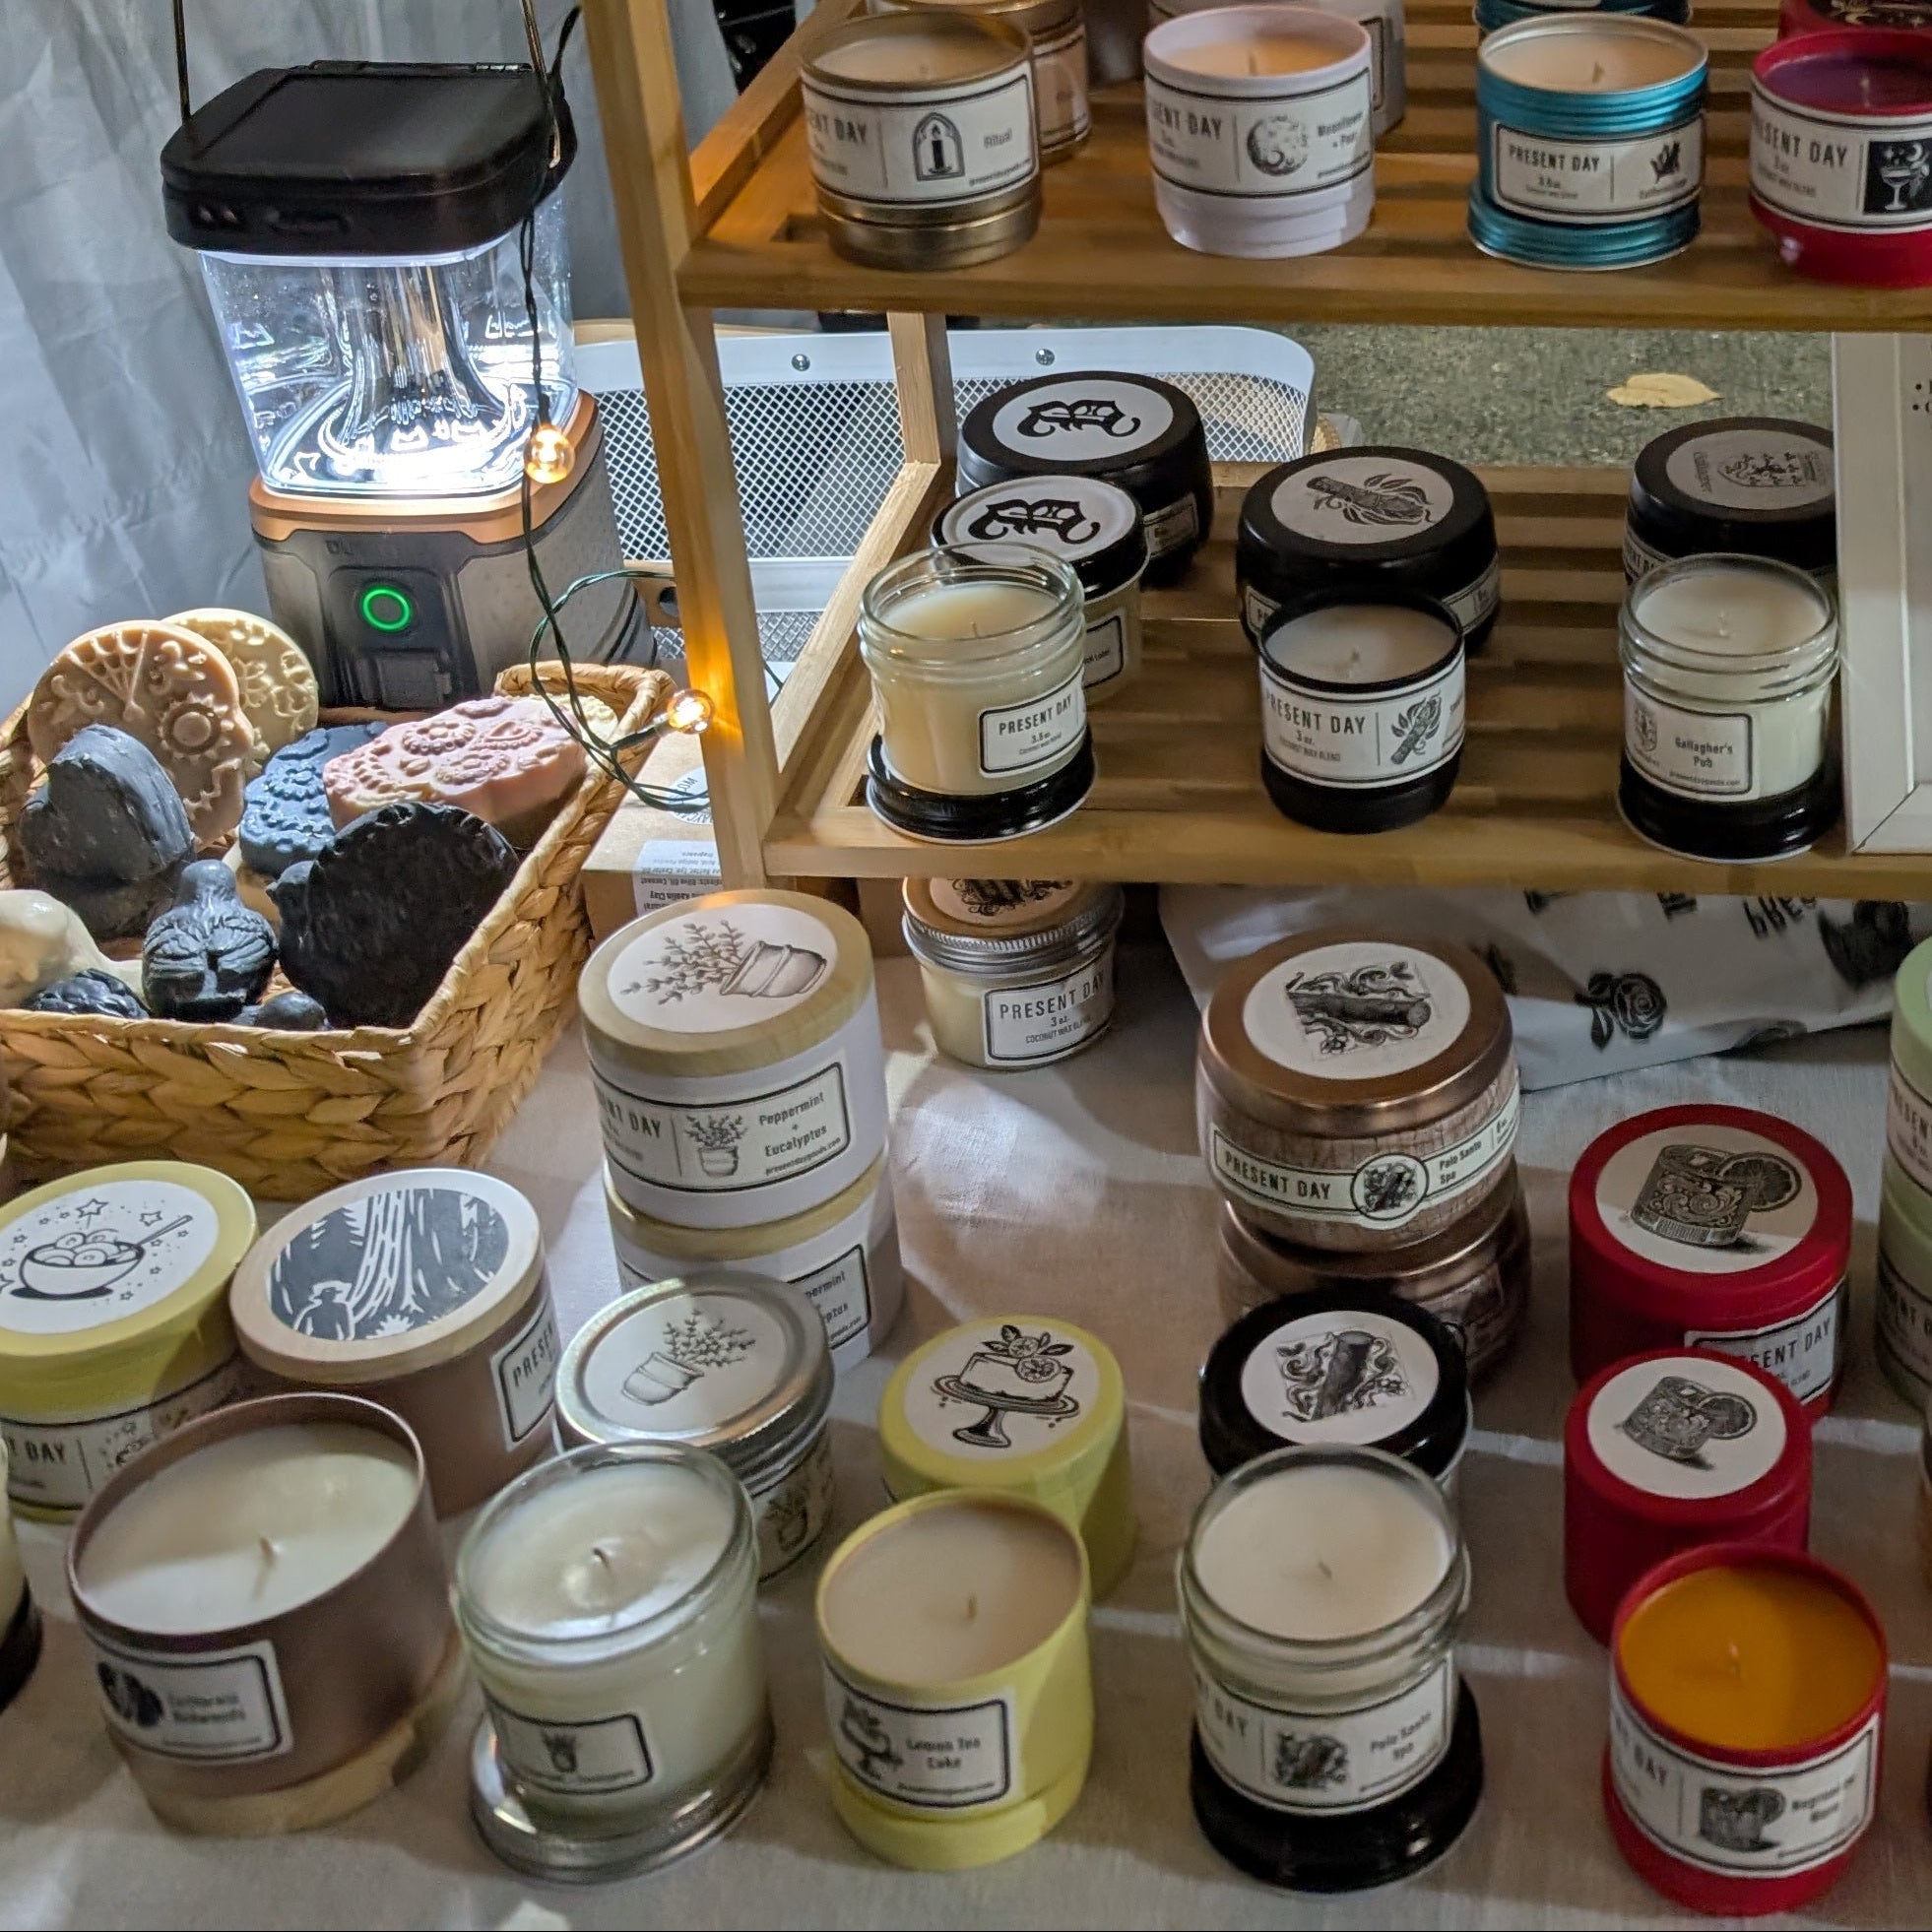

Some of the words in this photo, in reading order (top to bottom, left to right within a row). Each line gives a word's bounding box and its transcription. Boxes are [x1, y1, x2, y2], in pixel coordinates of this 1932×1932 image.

[834, 117, 868, 144] DAY
[1187, 111, 1222, 140] DAY
[1509, 145, 1566, 171] PRESENT
[1572, 155, 1600, 172] DAY
[1809, 141, 1847, 168] DAY
[998, 704, 1053, 736] PRESENT
[1057, 694, 1072, 717] DAY
[1265, 691, 1321, 731] PRESENT
[1331, 716, 1367, 735] DAY
[1675, 736, 1734, 755] Gallagher's
[1693, 755, 1713, 769] Pub
[999, 989, 1077, 1019] PRESENT
[1051, 1016, 1058, 1027] 3
[1026, 1029, 1058, 1044] COCONUT
[758, 1091, 825, 1126] Peppermint
[628, 1111, 662, 1138] DAY
[764, 1125, 827, 1158] Eucalyptus
[1224, 1152, 1289, 1193] PRESENT
[1297, 1180, 1331, 1200] DAY
[1439, 1155, 1458, 1171] Palo
[1440, 1171, 1457, 1185] Spa
[1804, 1317, 1832, 1353] DAY
[25, 1441, 66, 1465] DAY
